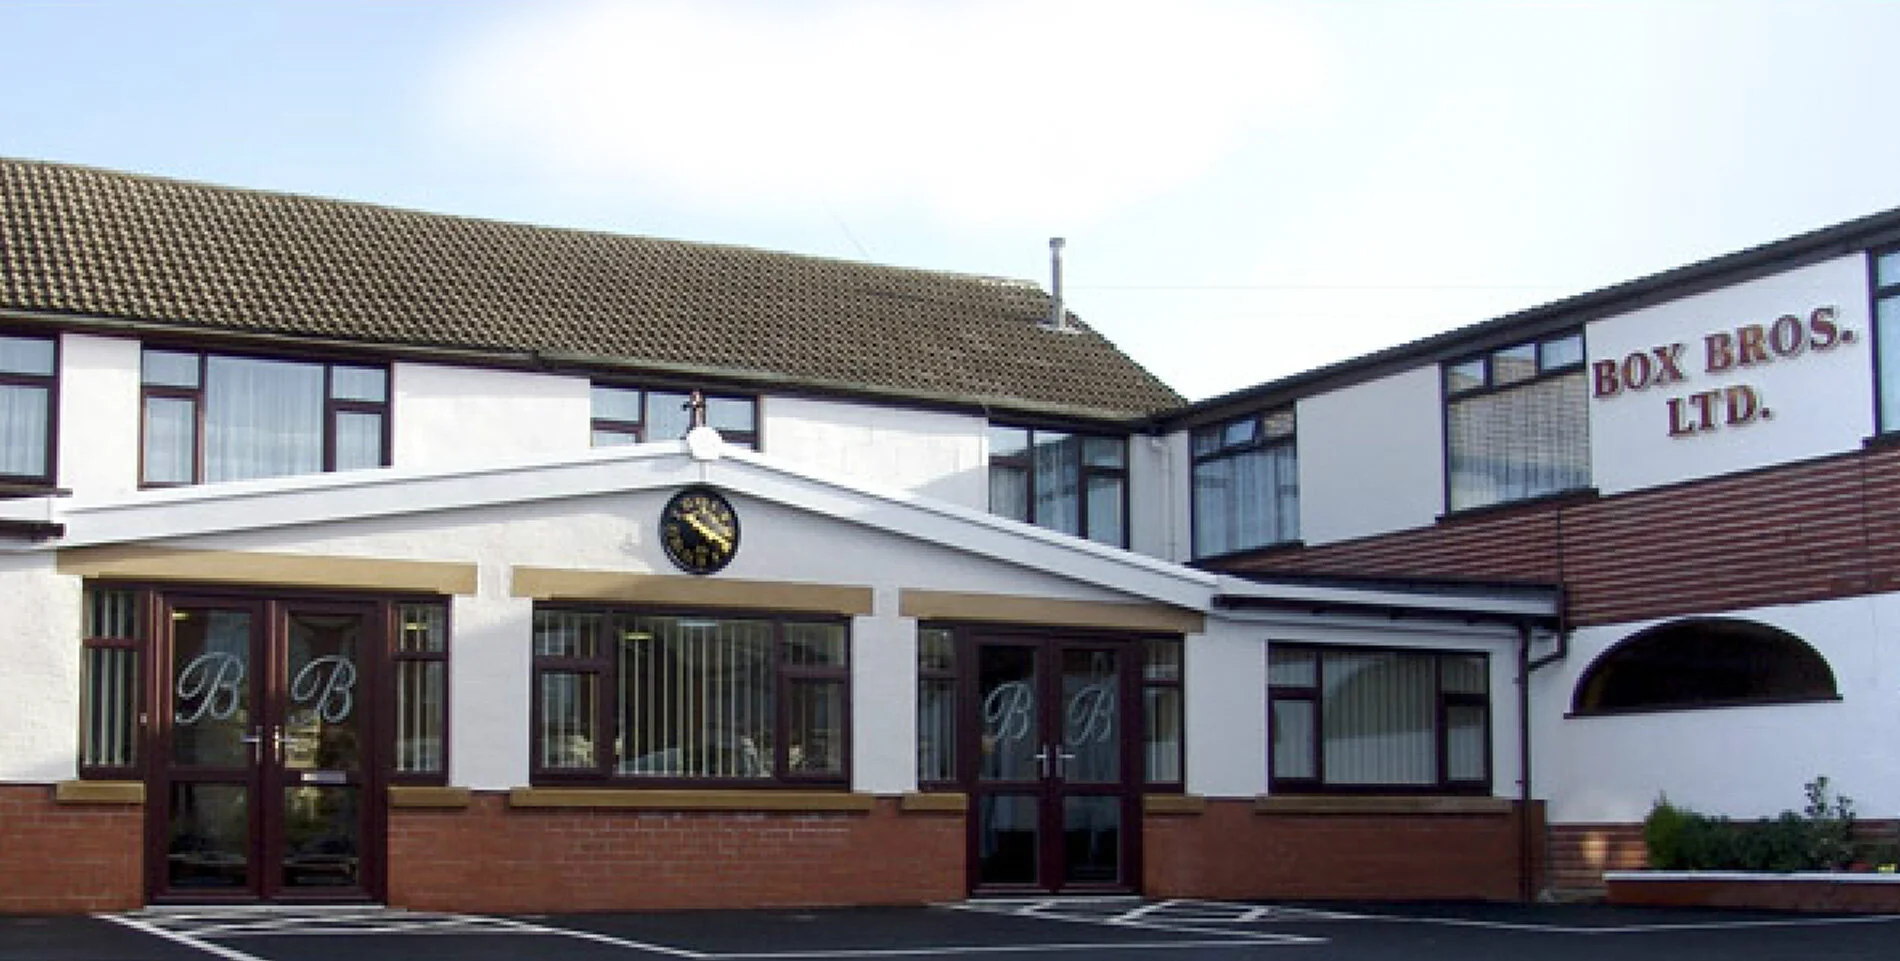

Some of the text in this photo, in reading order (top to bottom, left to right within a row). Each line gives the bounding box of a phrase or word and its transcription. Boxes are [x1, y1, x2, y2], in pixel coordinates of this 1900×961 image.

[1592, 305, 1857, 398] BOX BROS.
[1666, 385, 1773, 437] LTD.
[176, 651, 244, 723] B
[291, 654, 357, 723] B
[984, 681, 1032, 742] B
[1068, 683, 1114, 746] B
